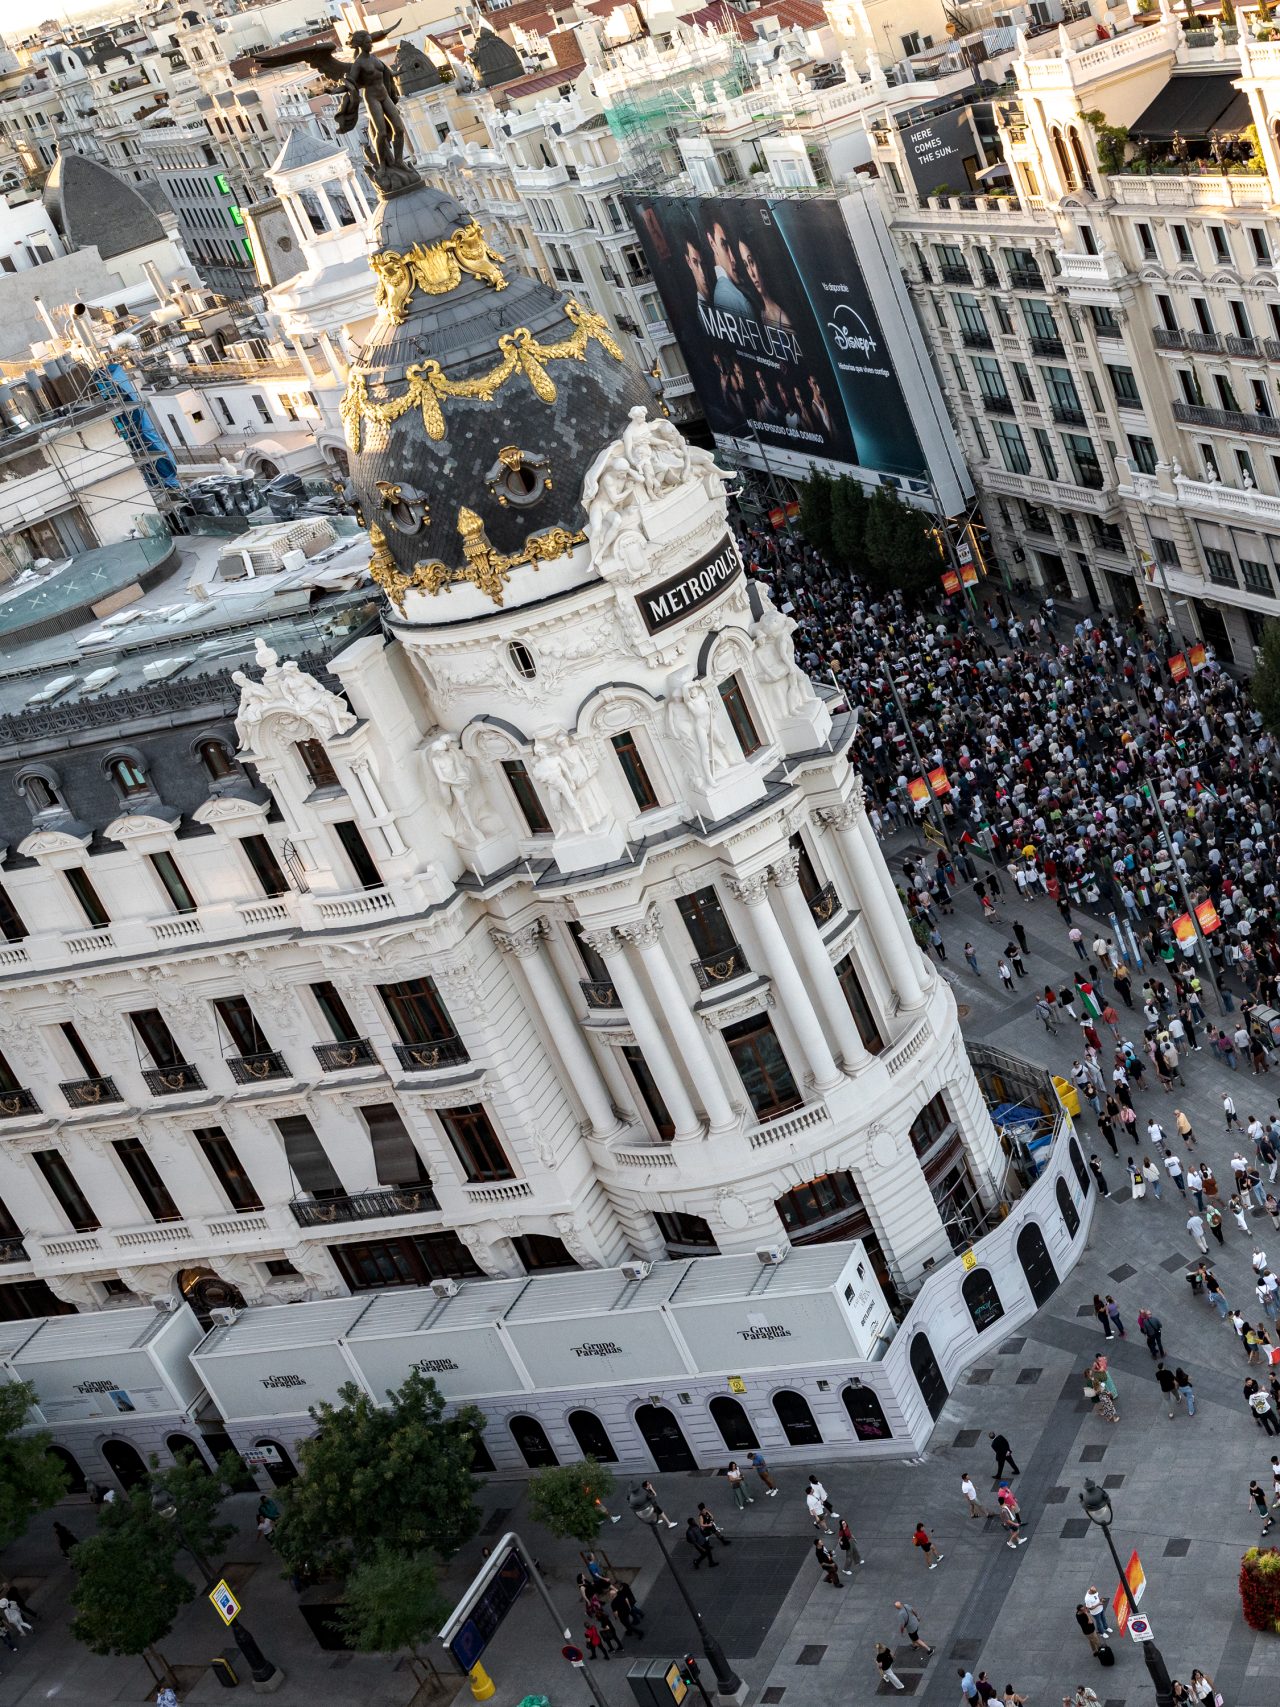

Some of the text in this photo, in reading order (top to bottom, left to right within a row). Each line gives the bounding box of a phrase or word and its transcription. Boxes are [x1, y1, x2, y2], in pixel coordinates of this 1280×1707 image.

[911, 128, 933, 143] HERE
[914, 137, 942, 154] COMES
[918, 145, 959, 165] THE SUN...
[746, 419, 824, 444] NEVO EPISODIO CADA DOMINGO
[648, 547, 738, 622] METROPOLIS
[750, 1325, 784, 1335] Grupo
[743, 1330, 792, 1341] Paraguas
[582, 1341, 615, 1351] Grupo
[576, 1347, 623, 1357] Paraguas
[420, 1358, 452, 1368] Grupo
[262, 1379, 307, 1389] Paraguas
[269, 1374, 299, 1384] Grupo
[83, 1380, 112, 1389] Grupo
